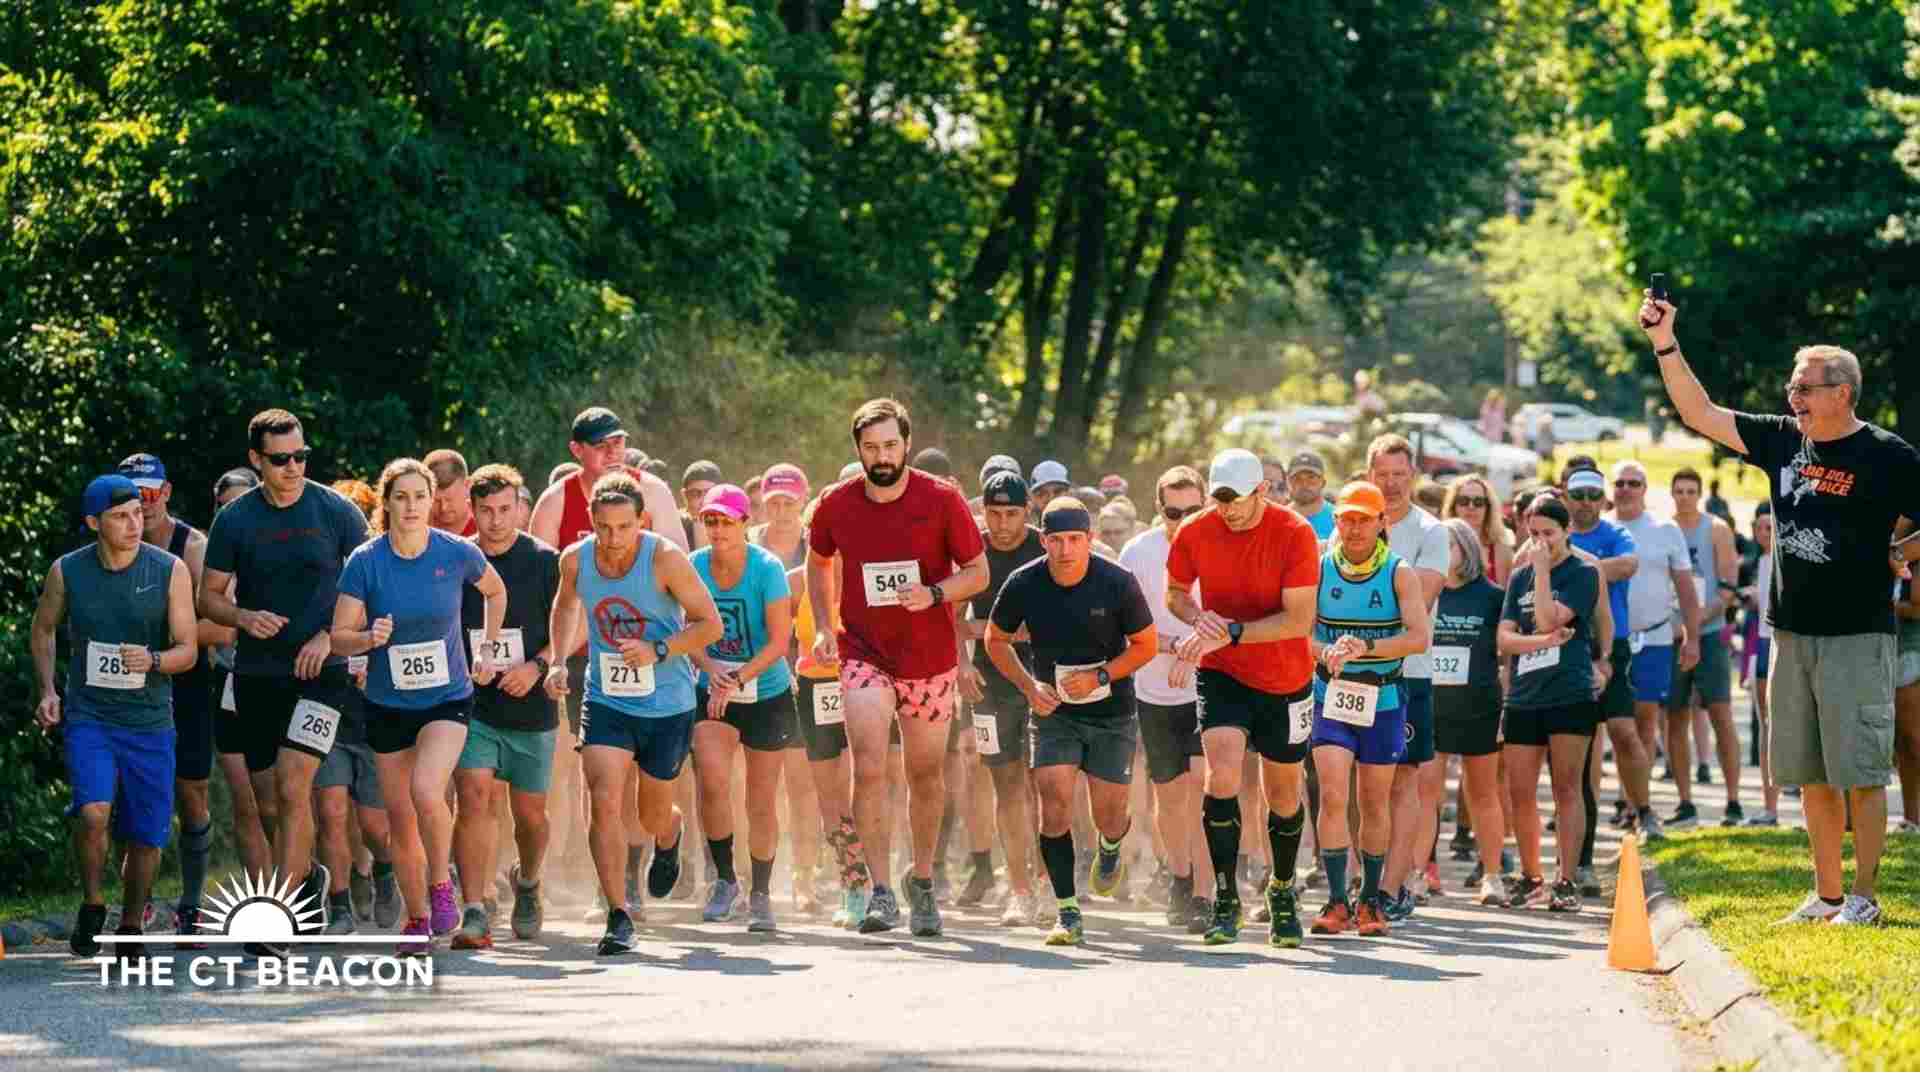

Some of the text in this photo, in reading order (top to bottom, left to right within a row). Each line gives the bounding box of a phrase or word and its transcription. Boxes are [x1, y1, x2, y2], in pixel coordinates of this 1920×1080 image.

[402, 656, 435, 675] 265
[610, 666, 640, 684] 271
[821, 695, 845, 711] 52
[302, 714, 333, 738] 265
